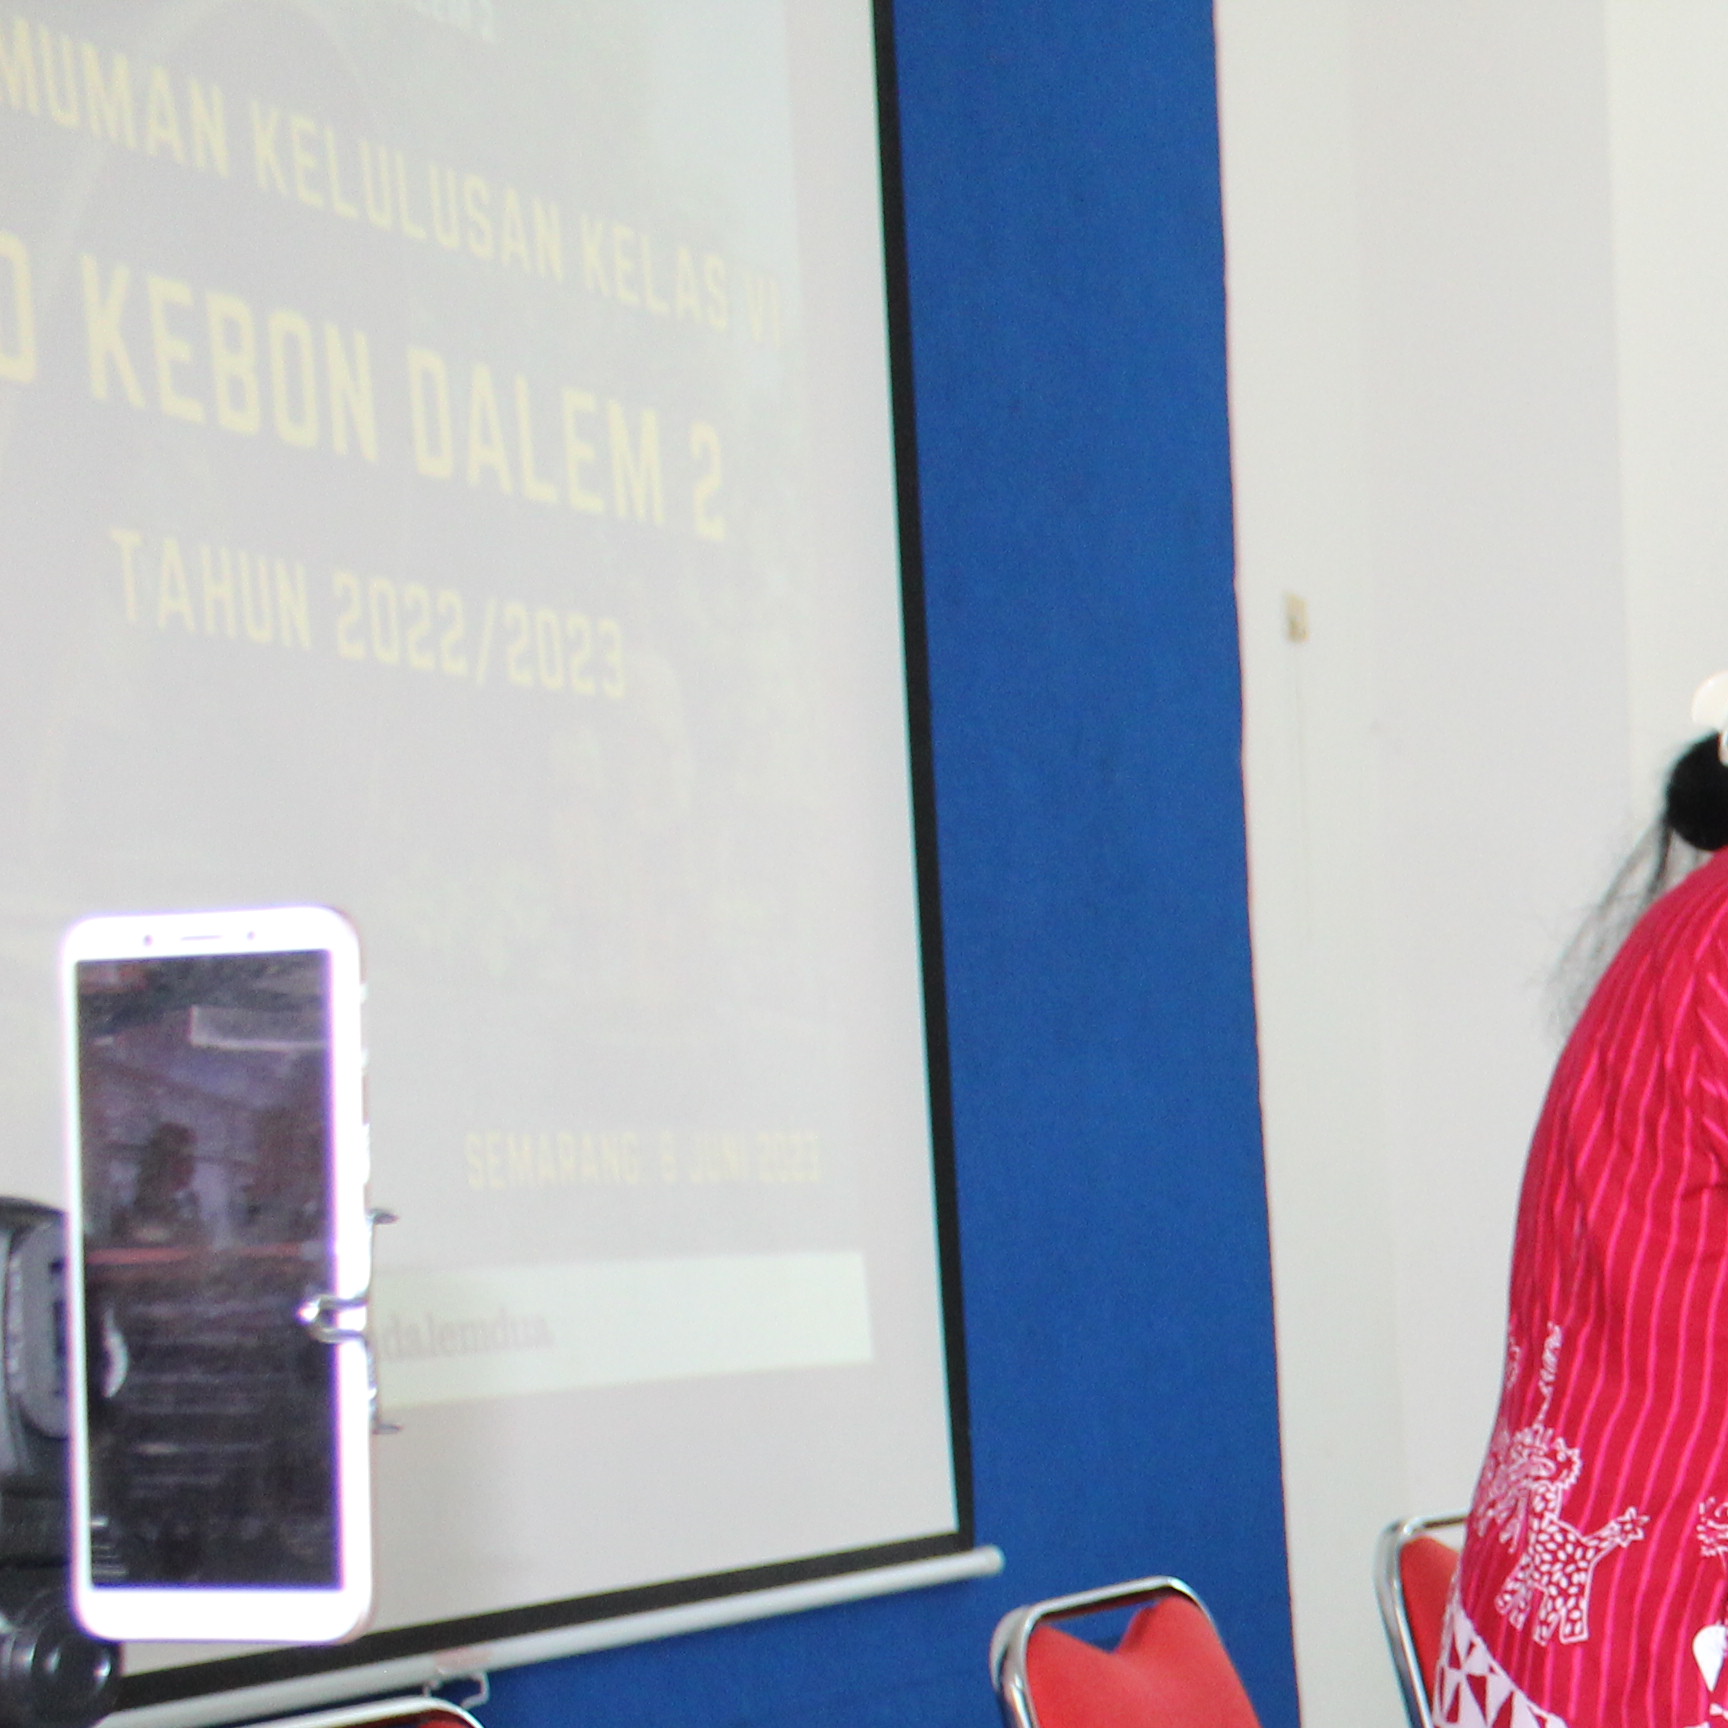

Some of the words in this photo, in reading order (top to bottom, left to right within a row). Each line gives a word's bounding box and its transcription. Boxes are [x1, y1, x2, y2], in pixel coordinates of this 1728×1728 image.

[250, 97, 564, 282] KELULUSAN
[581, 212, 729, 332] KELAS
[742, 270, 782, 346] VI
[80, 254, 379, 463] KEBON
[406, 345, 665, 527] DALEM
[690, 420, 728, 543] 2
[108, 526, 311, 651] TAHUN
[332, 569, 627, 700] 2022/2023
